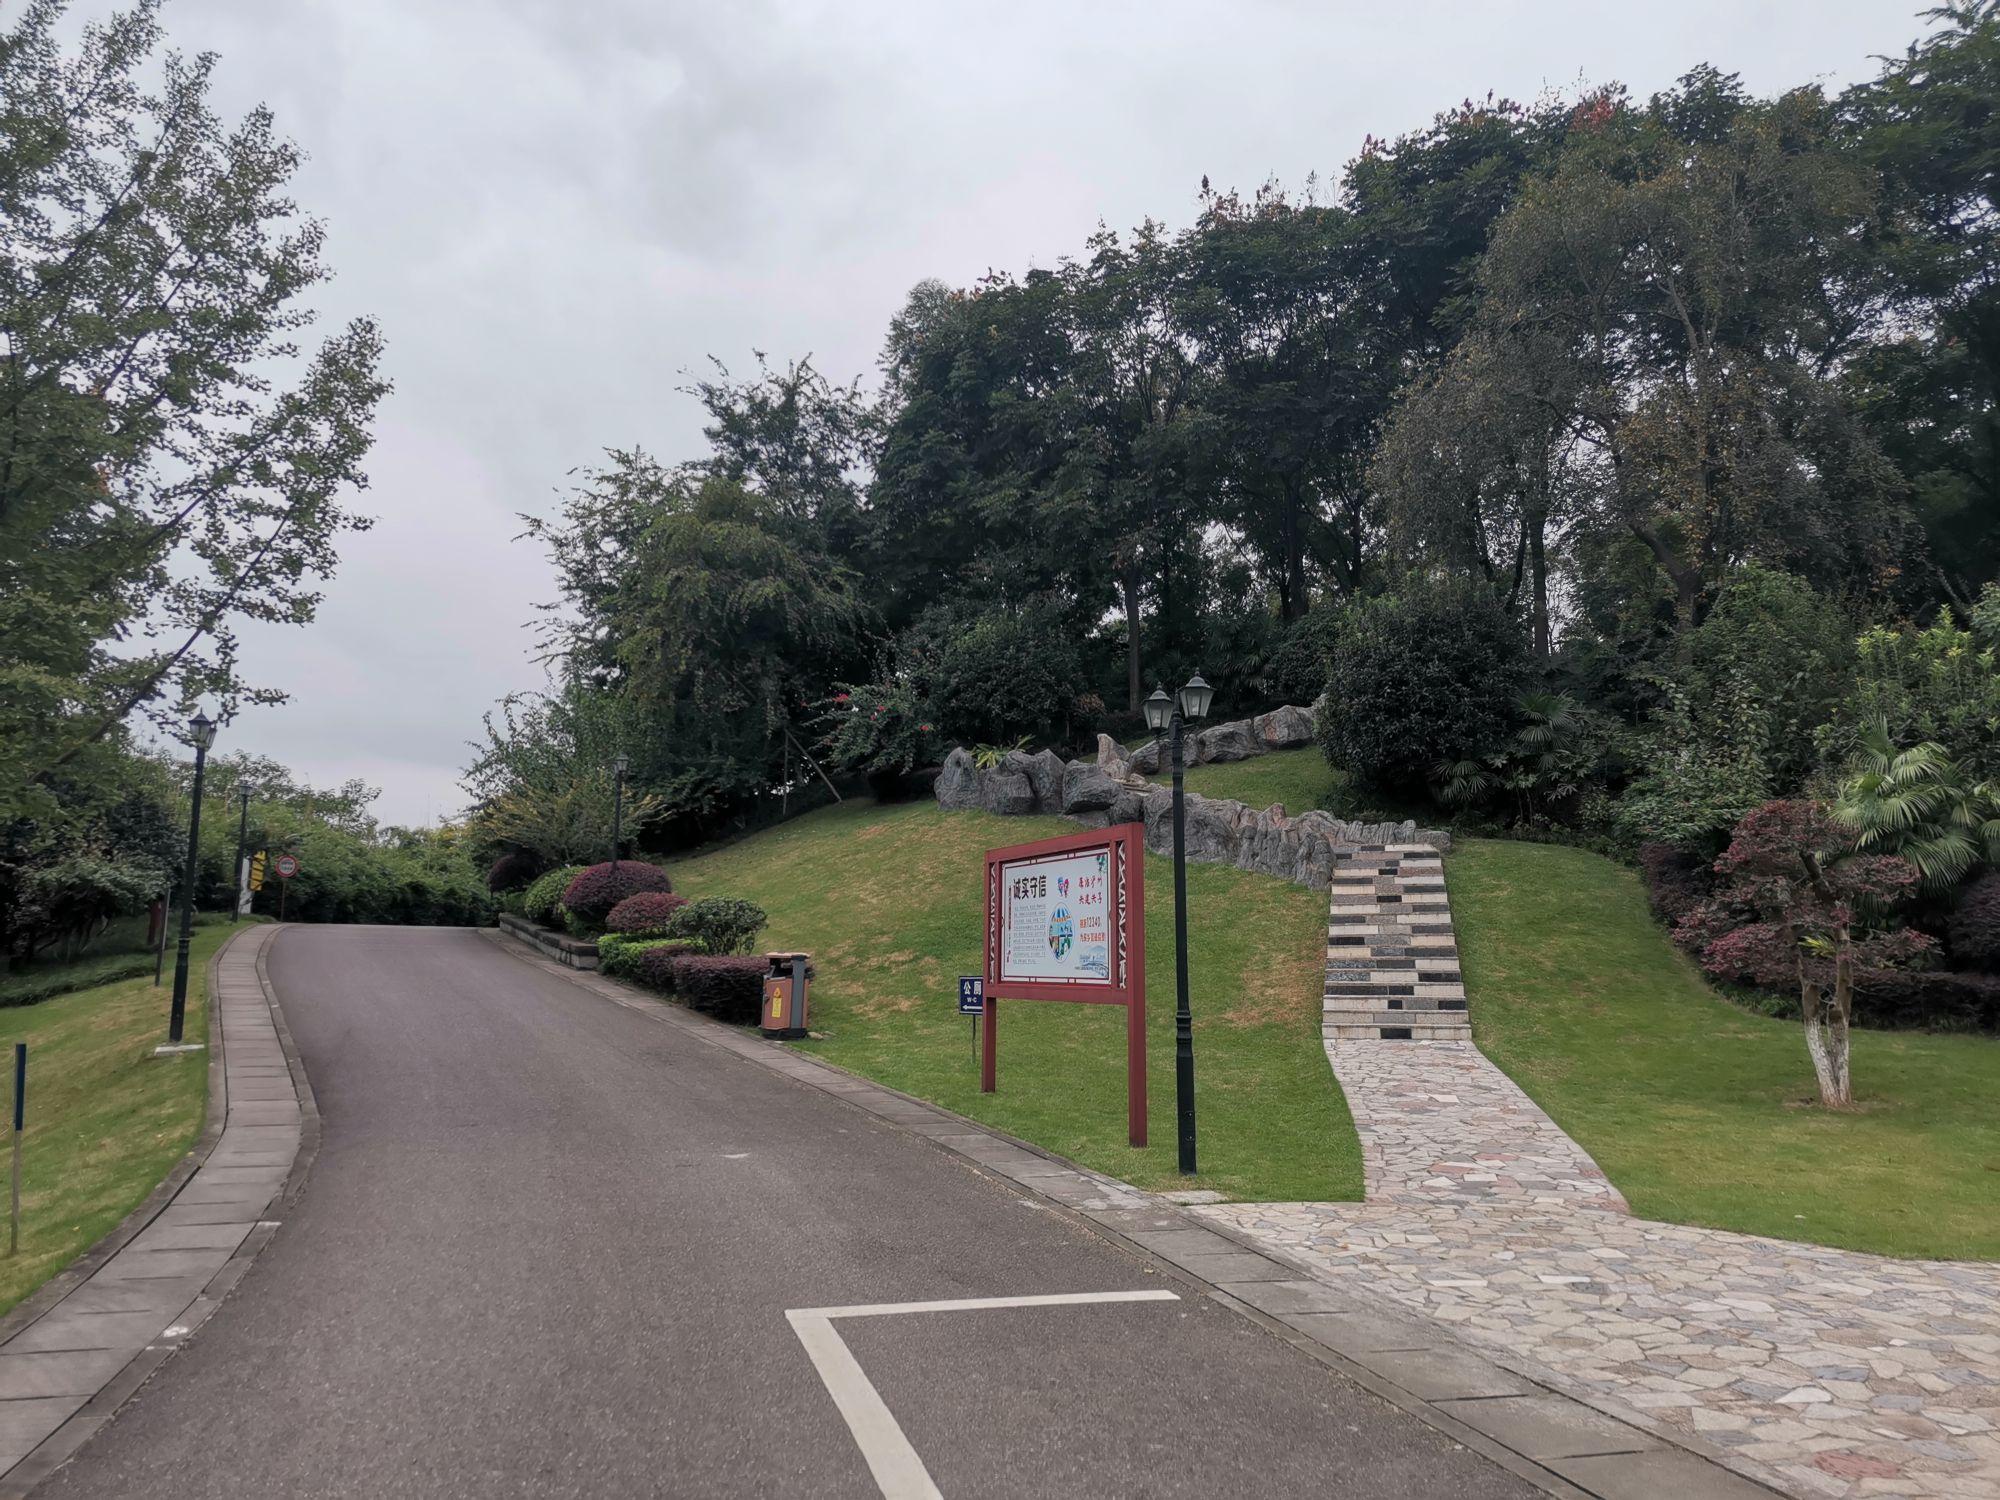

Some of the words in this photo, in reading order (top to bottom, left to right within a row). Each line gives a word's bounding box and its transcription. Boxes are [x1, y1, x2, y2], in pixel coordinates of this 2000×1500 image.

[1013, 875, 1047, 900] 诚实守信
[963, 981, 982, 995] 公厕
